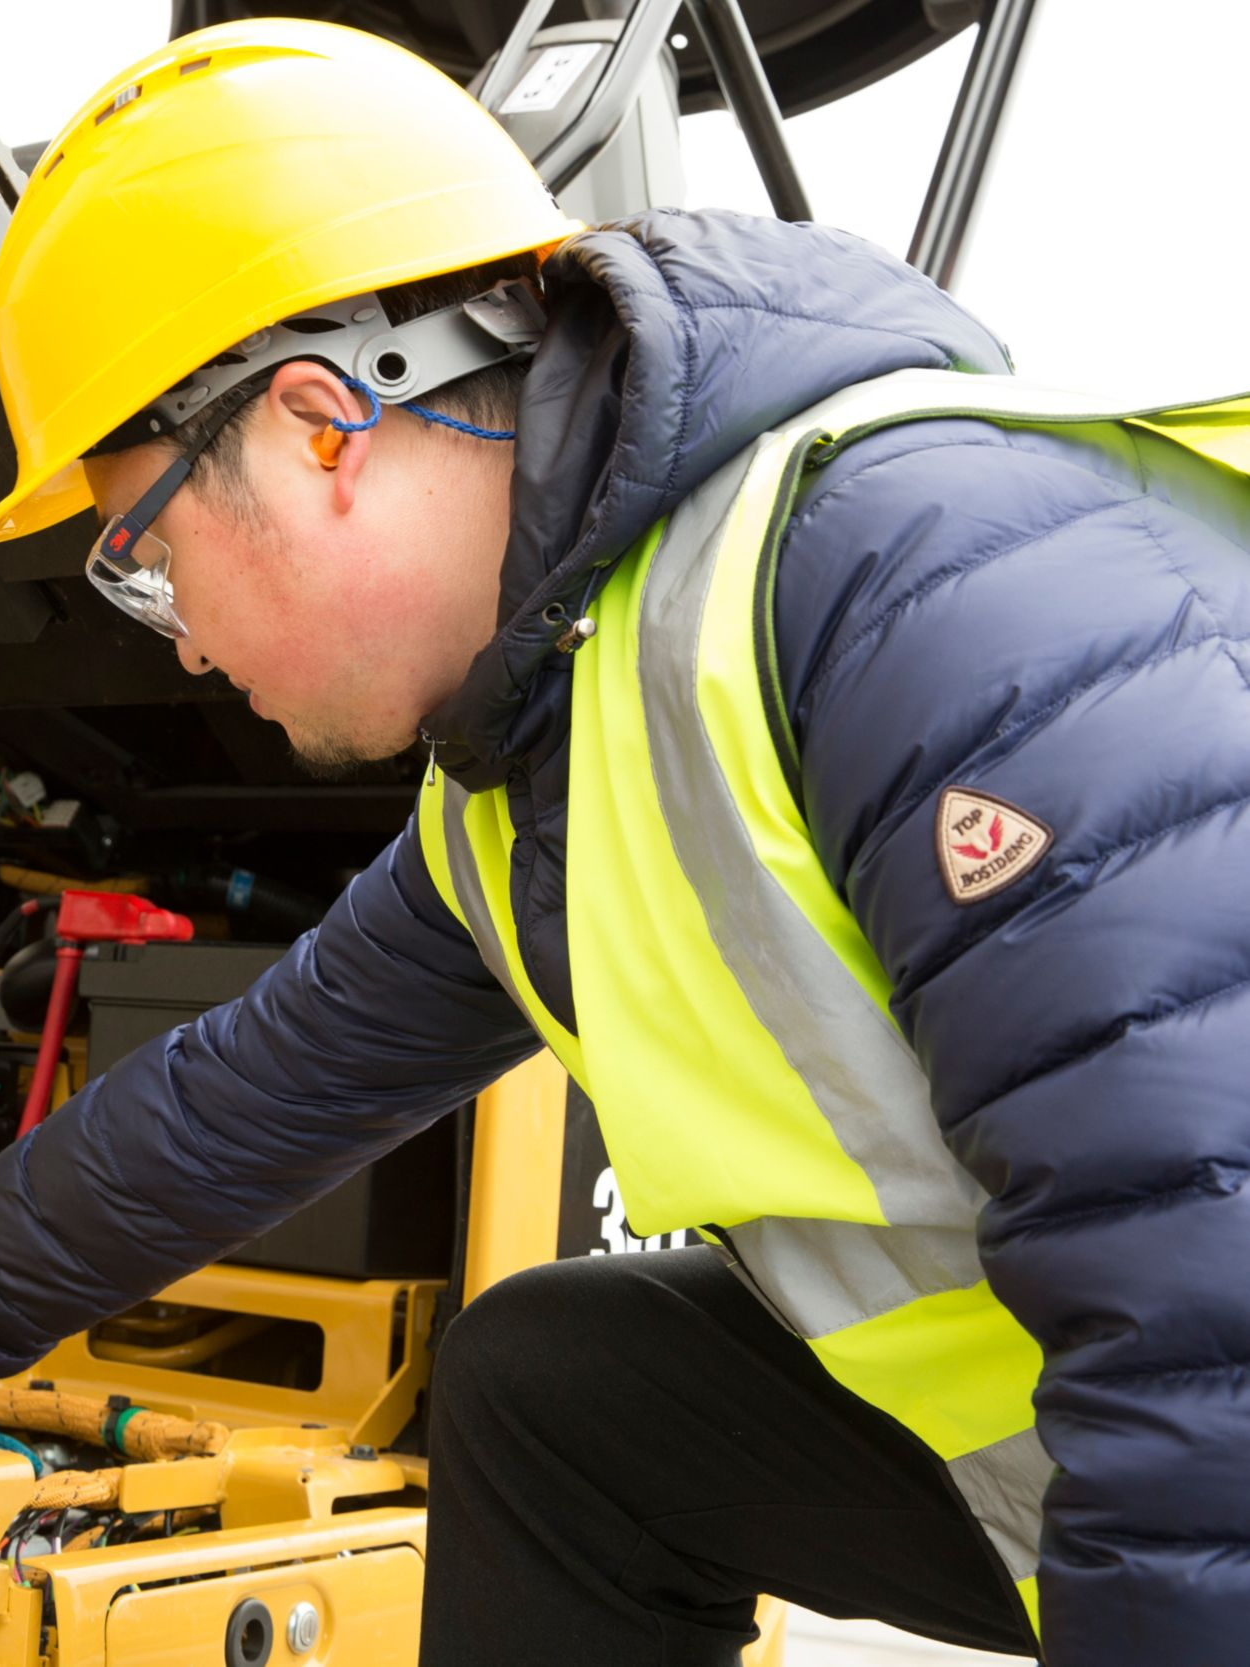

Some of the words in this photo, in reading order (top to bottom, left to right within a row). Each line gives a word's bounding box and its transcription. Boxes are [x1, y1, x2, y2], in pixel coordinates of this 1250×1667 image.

[110, 527, 131, 552] 3M
[952, 808, 983, 837] TOP
[960, 832, 1034, 888] BOSIDENG
